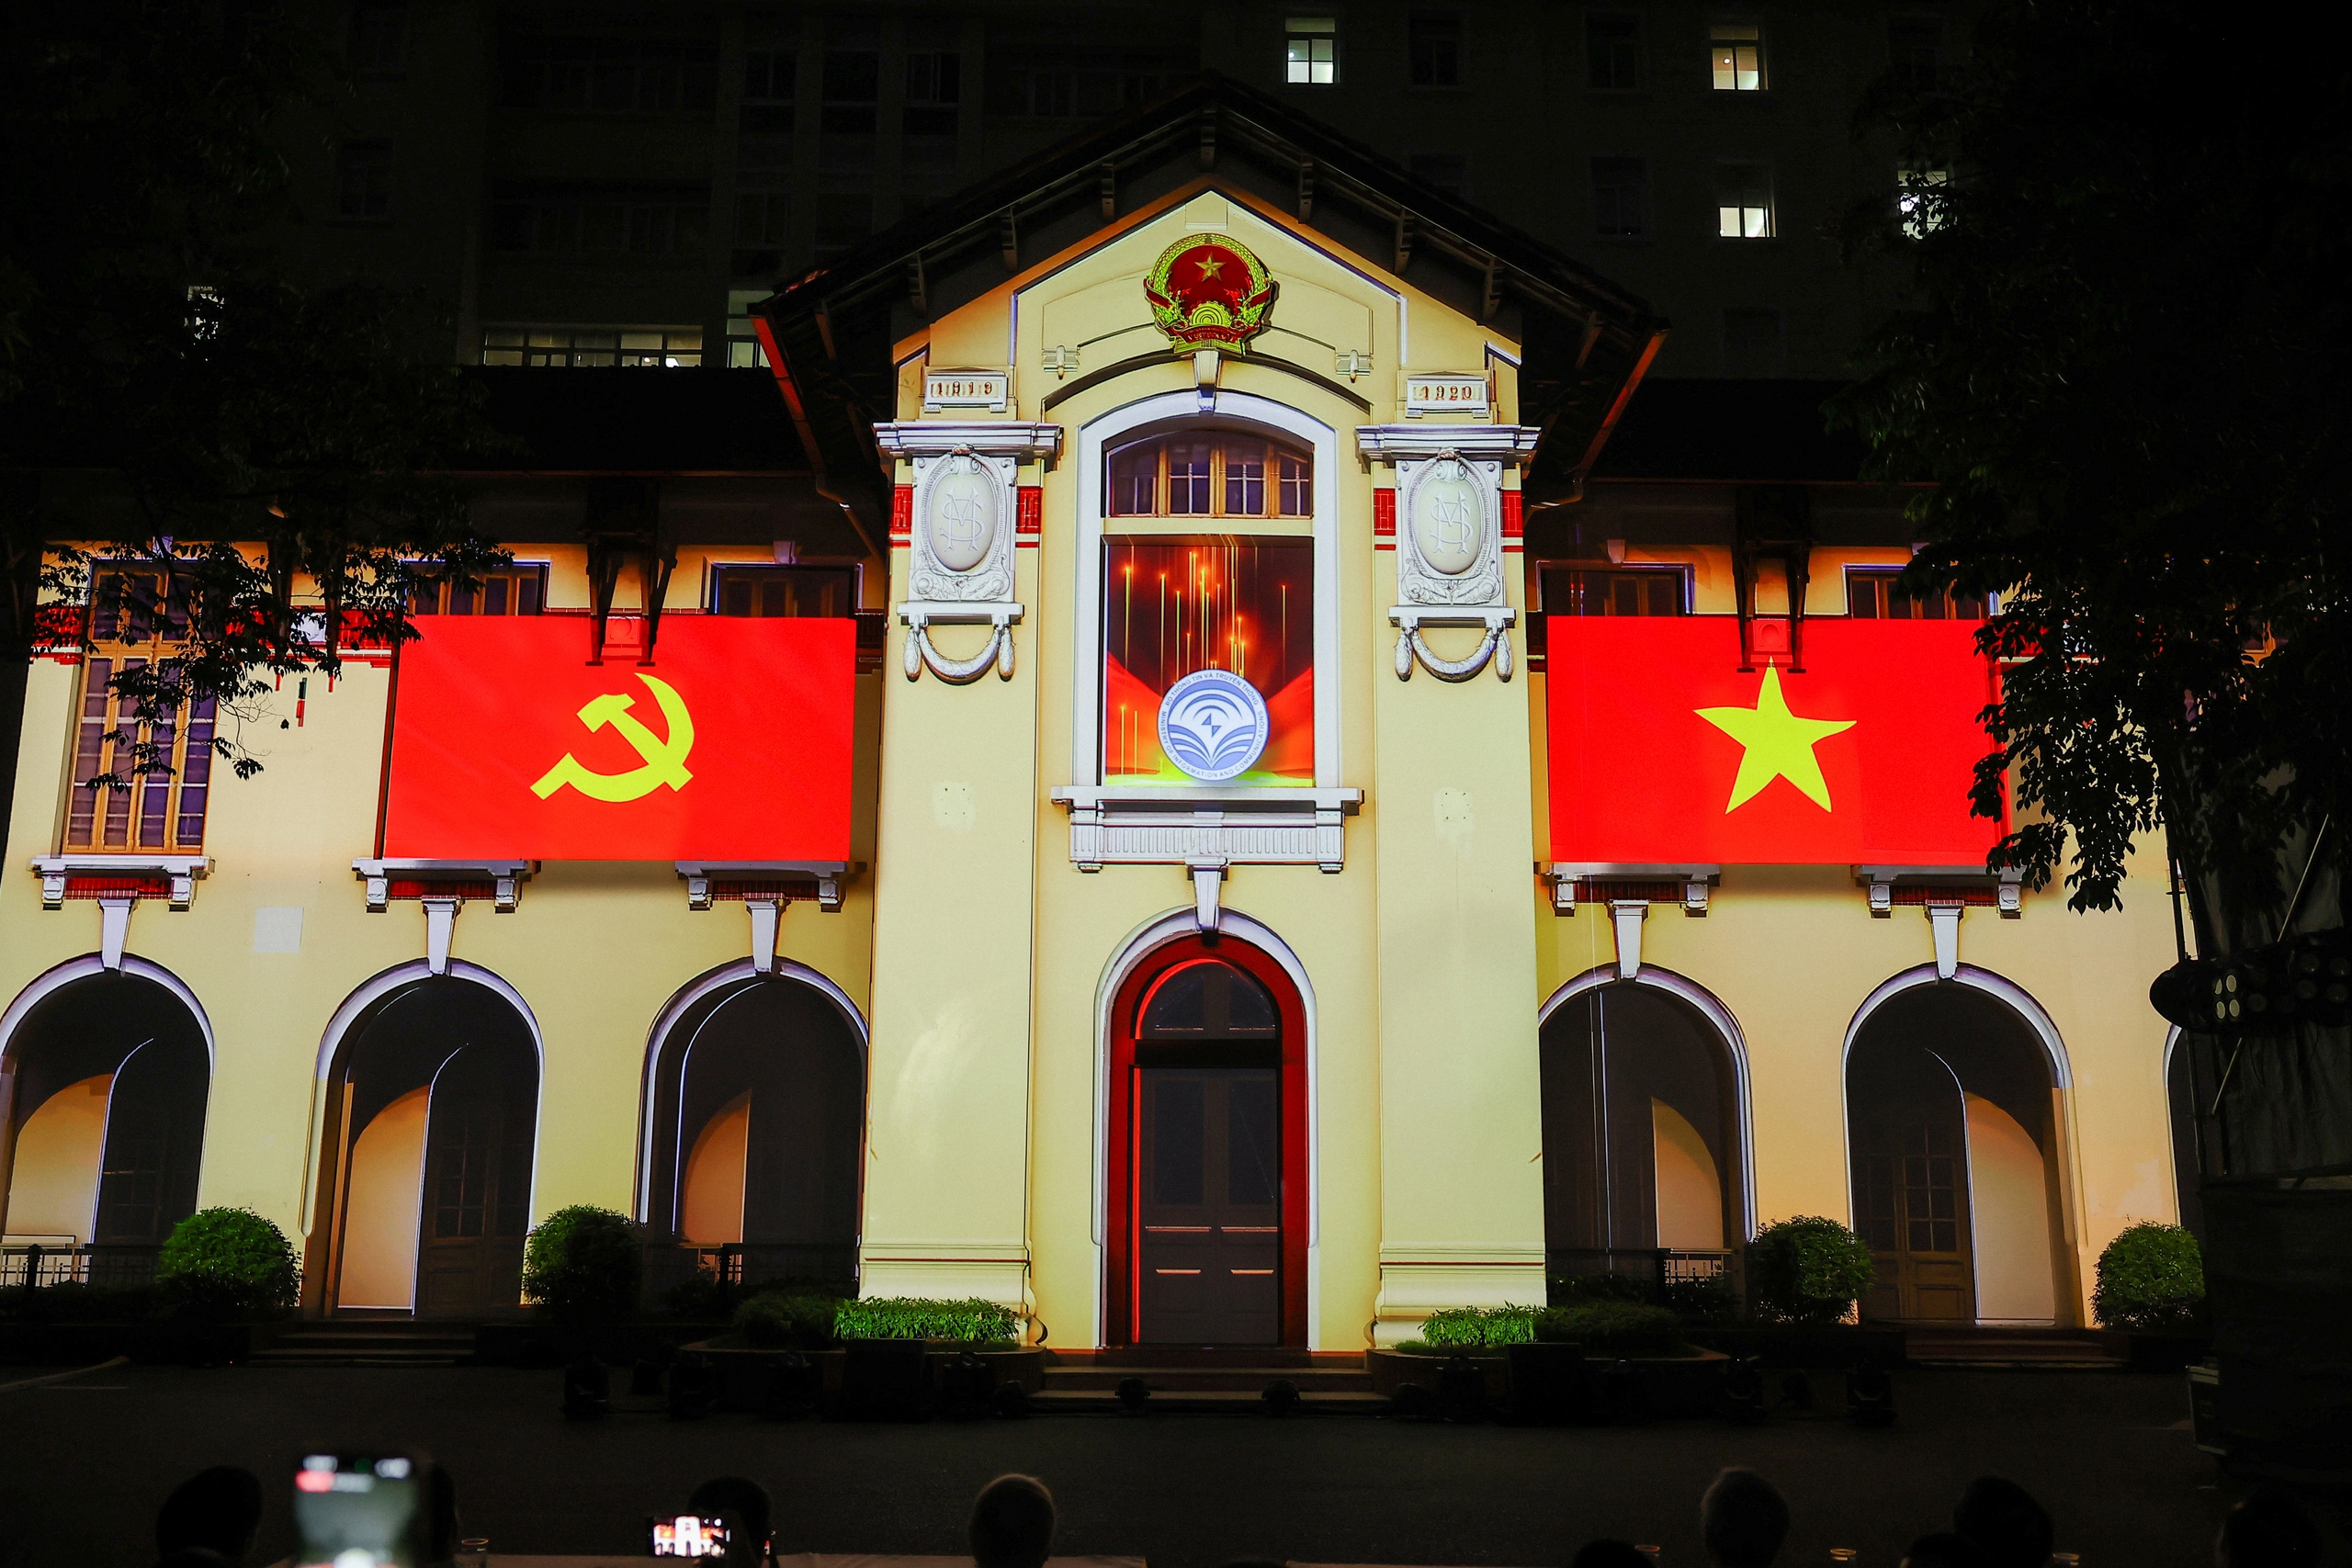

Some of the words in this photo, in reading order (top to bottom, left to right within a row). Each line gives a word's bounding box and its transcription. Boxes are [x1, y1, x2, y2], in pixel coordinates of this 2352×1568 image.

[1421, 386, 1472, 400] 1920
[1160, 711, 1169, 744] MINISTRY
[1167, 745, 1174, 753] OF
[1172, 755, 1217, 778] INFORMATION
[1219, 769, 1234, 777] AND
[1235, 710, 1265, 772] COMMUNICATIONS
